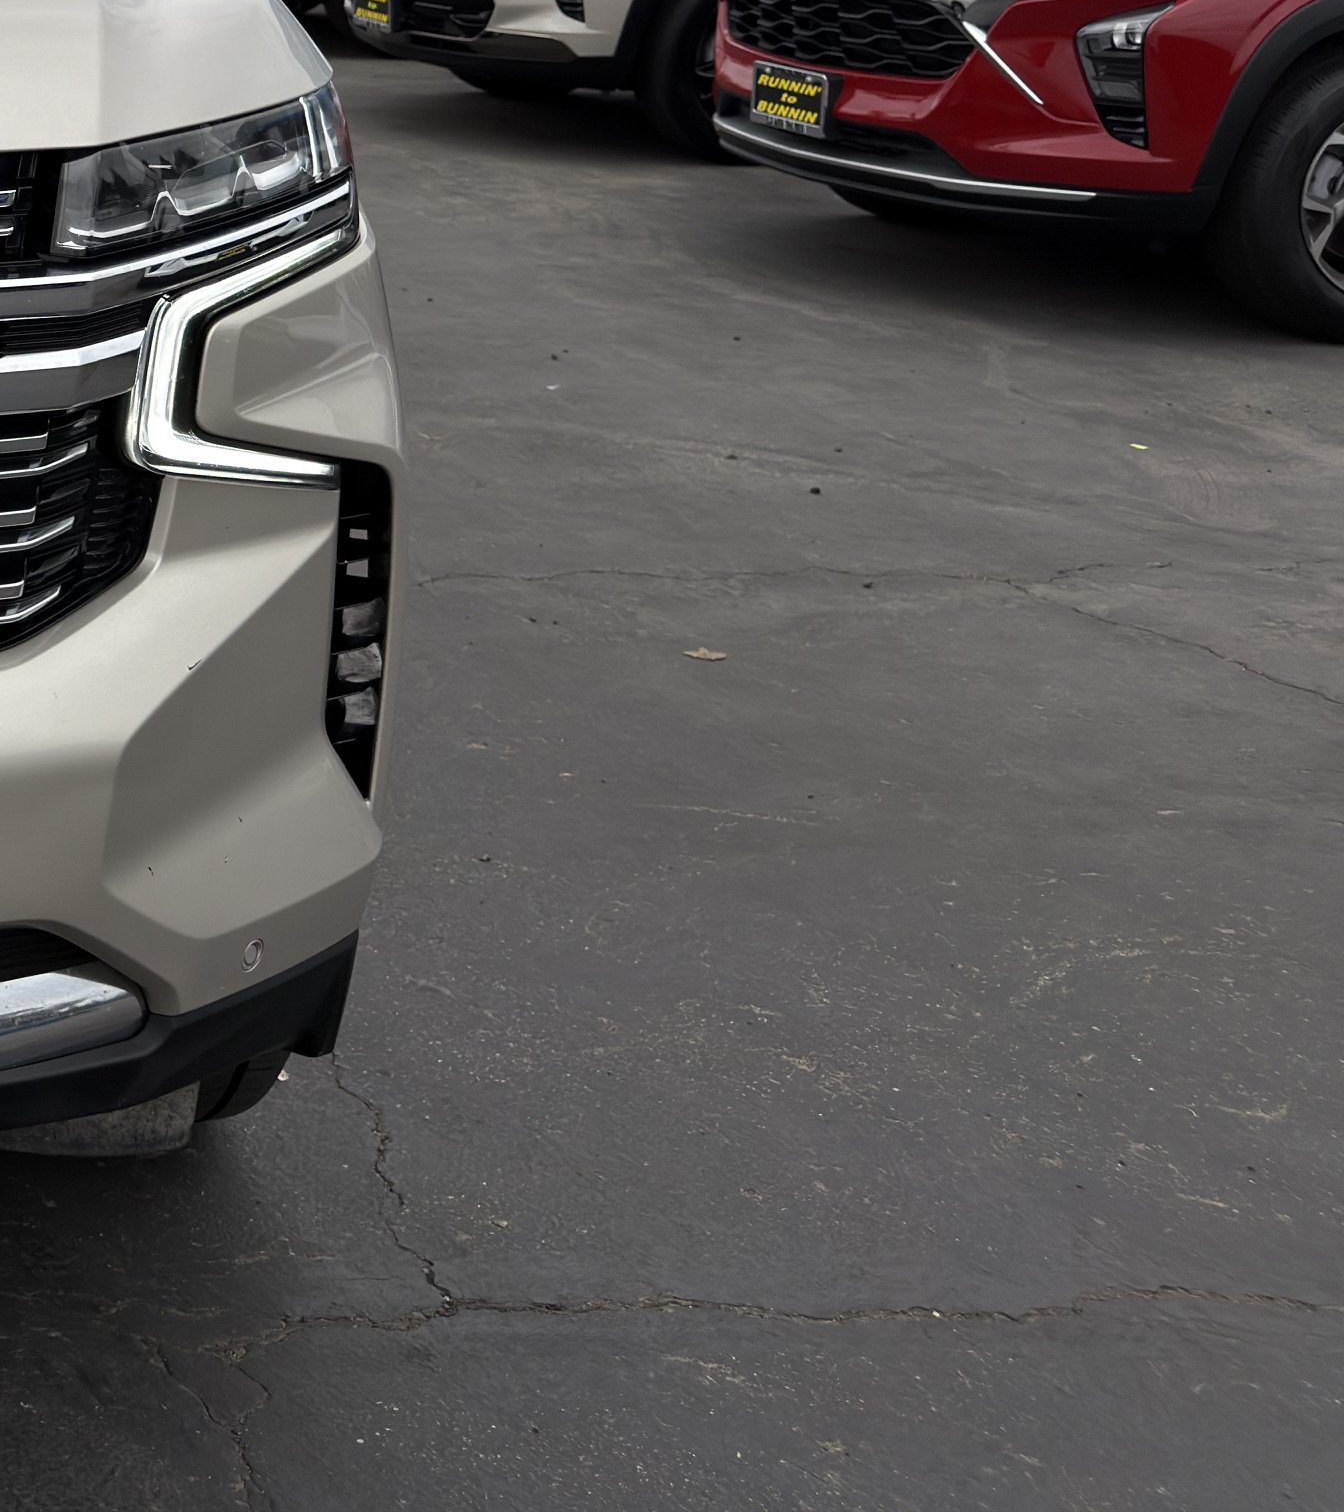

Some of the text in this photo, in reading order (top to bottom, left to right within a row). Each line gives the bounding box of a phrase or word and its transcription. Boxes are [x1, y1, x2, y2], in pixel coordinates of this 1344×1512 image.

[758, 74, 822, 96] RUNNIN'
[780, 92, 797, 104] to
[756, 100, 818, 124] BUNNIN
